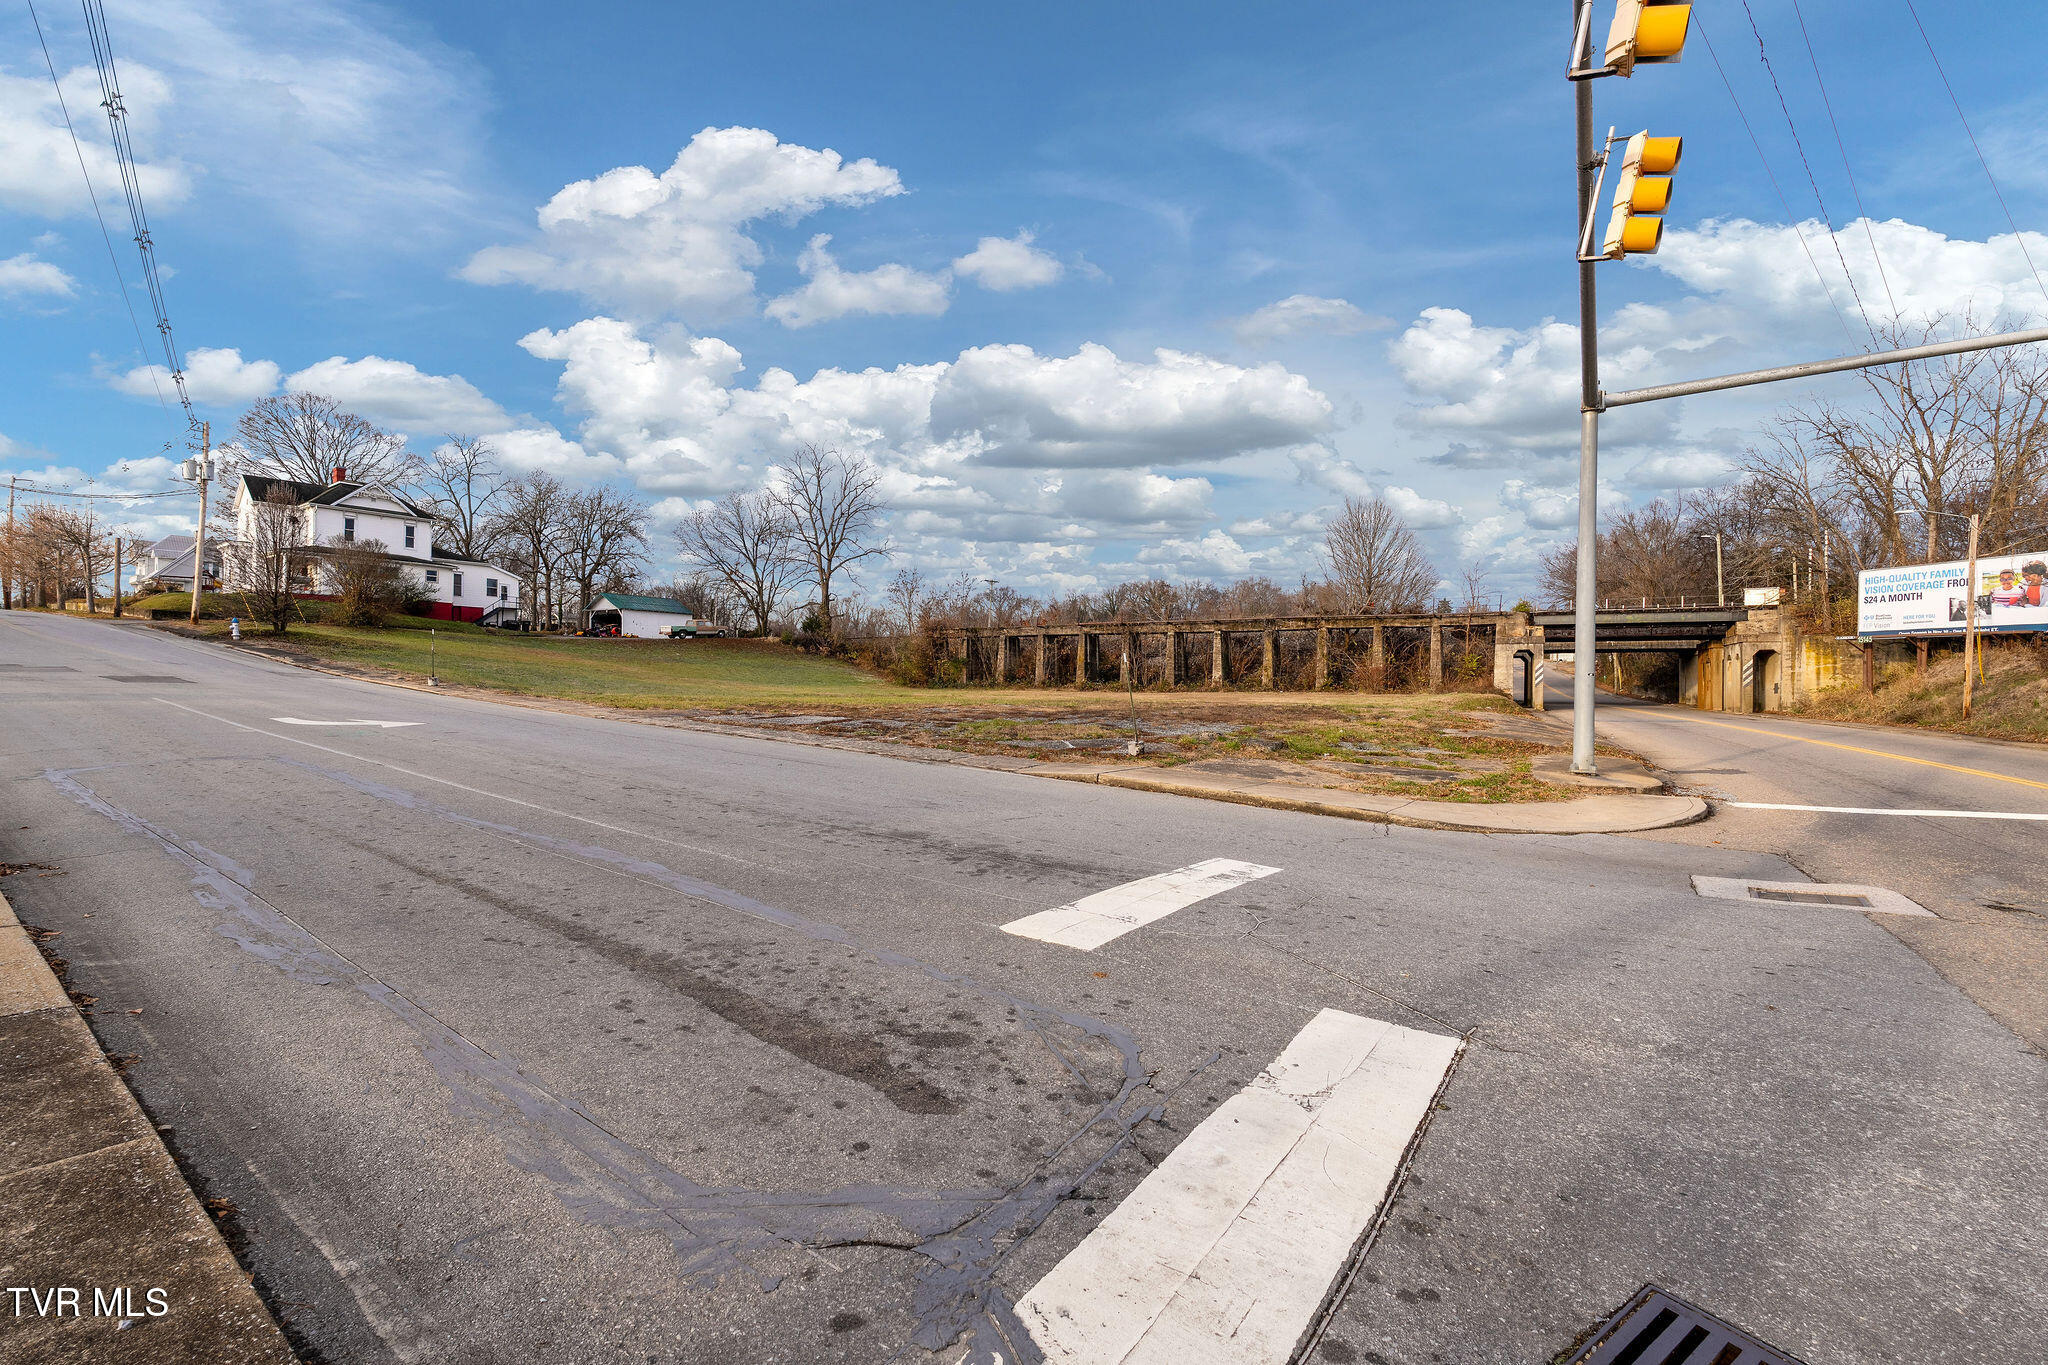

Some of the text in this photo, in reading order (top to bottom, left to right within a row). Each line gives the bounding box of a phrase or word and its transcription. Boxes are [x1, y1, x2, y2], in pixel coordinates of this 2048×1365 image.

[1865, 568, 1965, 585] HIGH-QUALITY FAMILY
[1864, 585, 1893, 594] VISION
[1896, 580, 1945, 592] COVERAGE
[1864, 592, 1923, 604] $24 A MONTH
